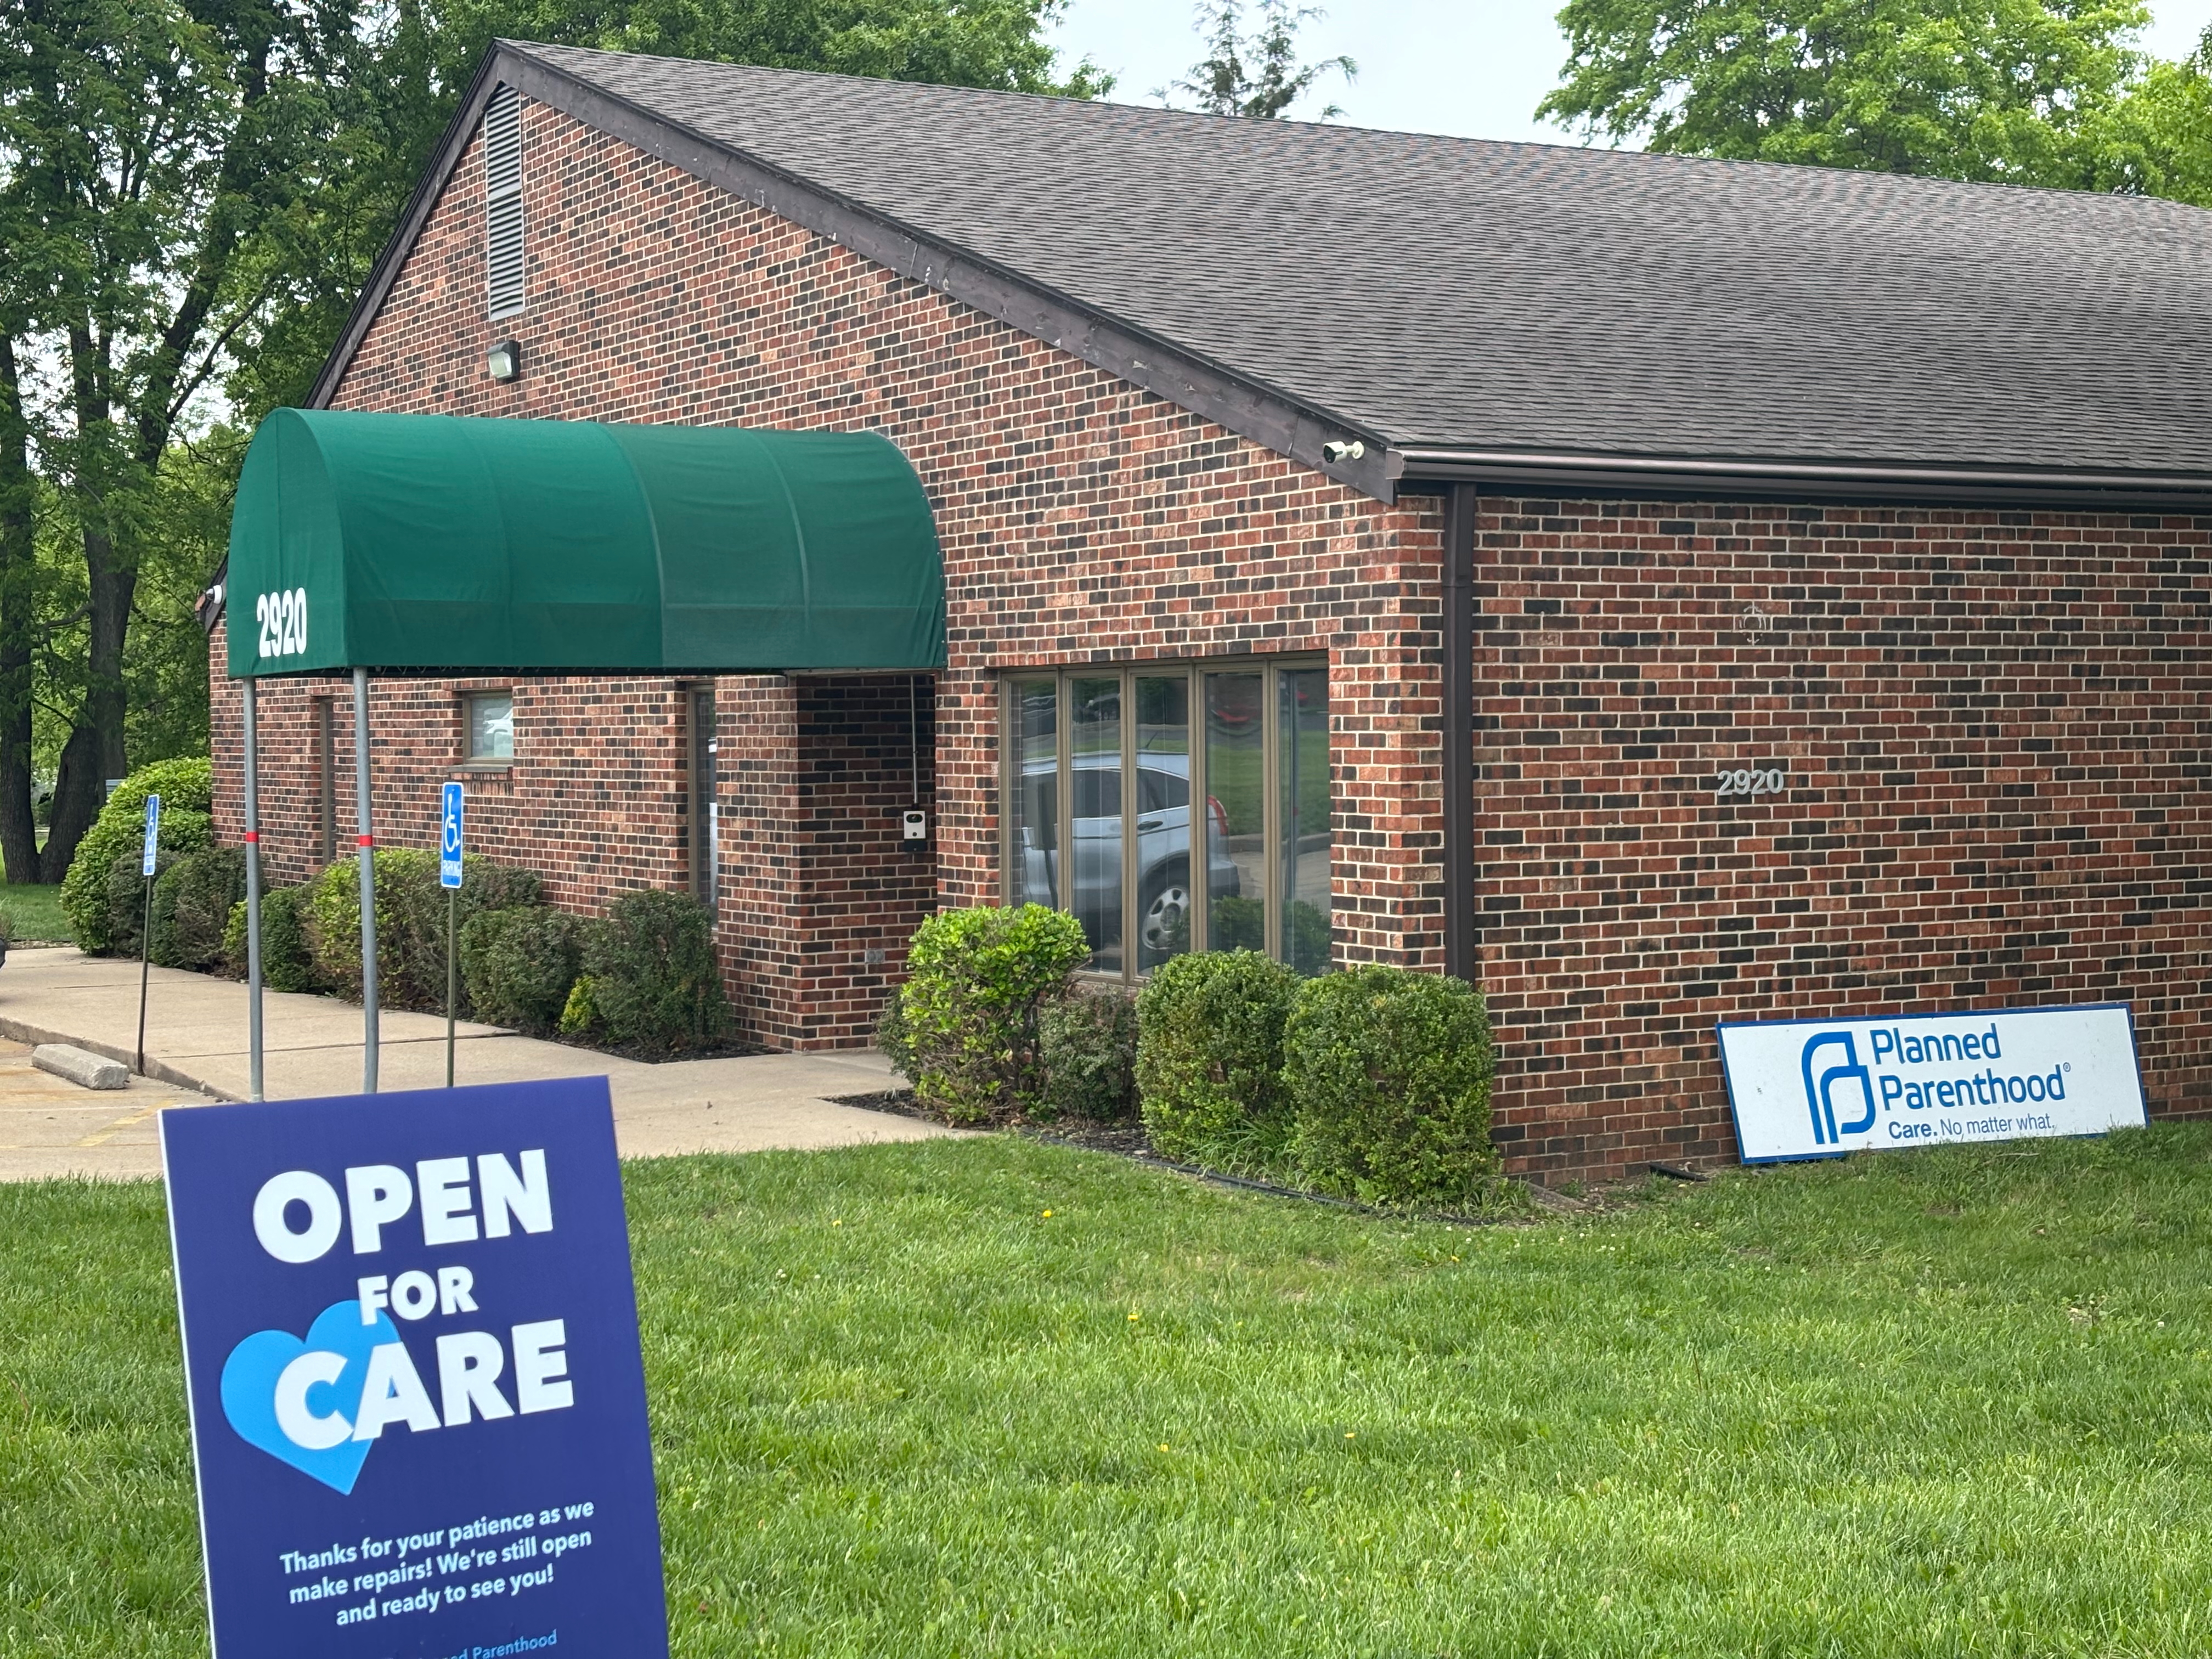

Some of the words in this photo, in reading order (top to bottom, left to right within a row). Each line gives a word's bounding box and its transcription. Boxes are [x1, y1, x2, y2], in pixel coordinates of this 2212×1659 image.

[257, 588, 307, 657] 2920
[1717, 768, 1784, 795] 2920
[1870, 1023, 2001, 1064] Planned
[1888, 1121, 1938, 1139] Care.
[1940, 1118, 1962, 1136] No
[1966, 1118, 2012, 1134] matter
[2016, 1113, 2055, 1131] what.
[253, 1149, 553, 1263] OPEN
[358, 1266, 478, 1325] FOR
[275, 1319, 574, 1449] CARE
[280, 1544, 357, 1573] Thanks
[361, 1537, 392, 1559] for
[397, 1531, 444, 1558] your
[449, 1516, 535, 1548] patience
[540, 1509, 560, 1525] as
[565, 1503, 594, 1520] we
[290, 1577, 348, 1603] make
[354, 1558, 432, 1593] repairs!
[437, 1549, 496, 1573] We're
[502, 1536, 537, 1561] still
[542, 1532, 591, 1557] open
[337, 1598, 376, 1625] and
[382, 1588, 439, 1616] ready
[444, 1586, 466, 1602] to
[471, 1579, 505, 1598] see
[510, 1564, 553, 1595] you!
[472, 1628, 557, 1659] Parenthood
